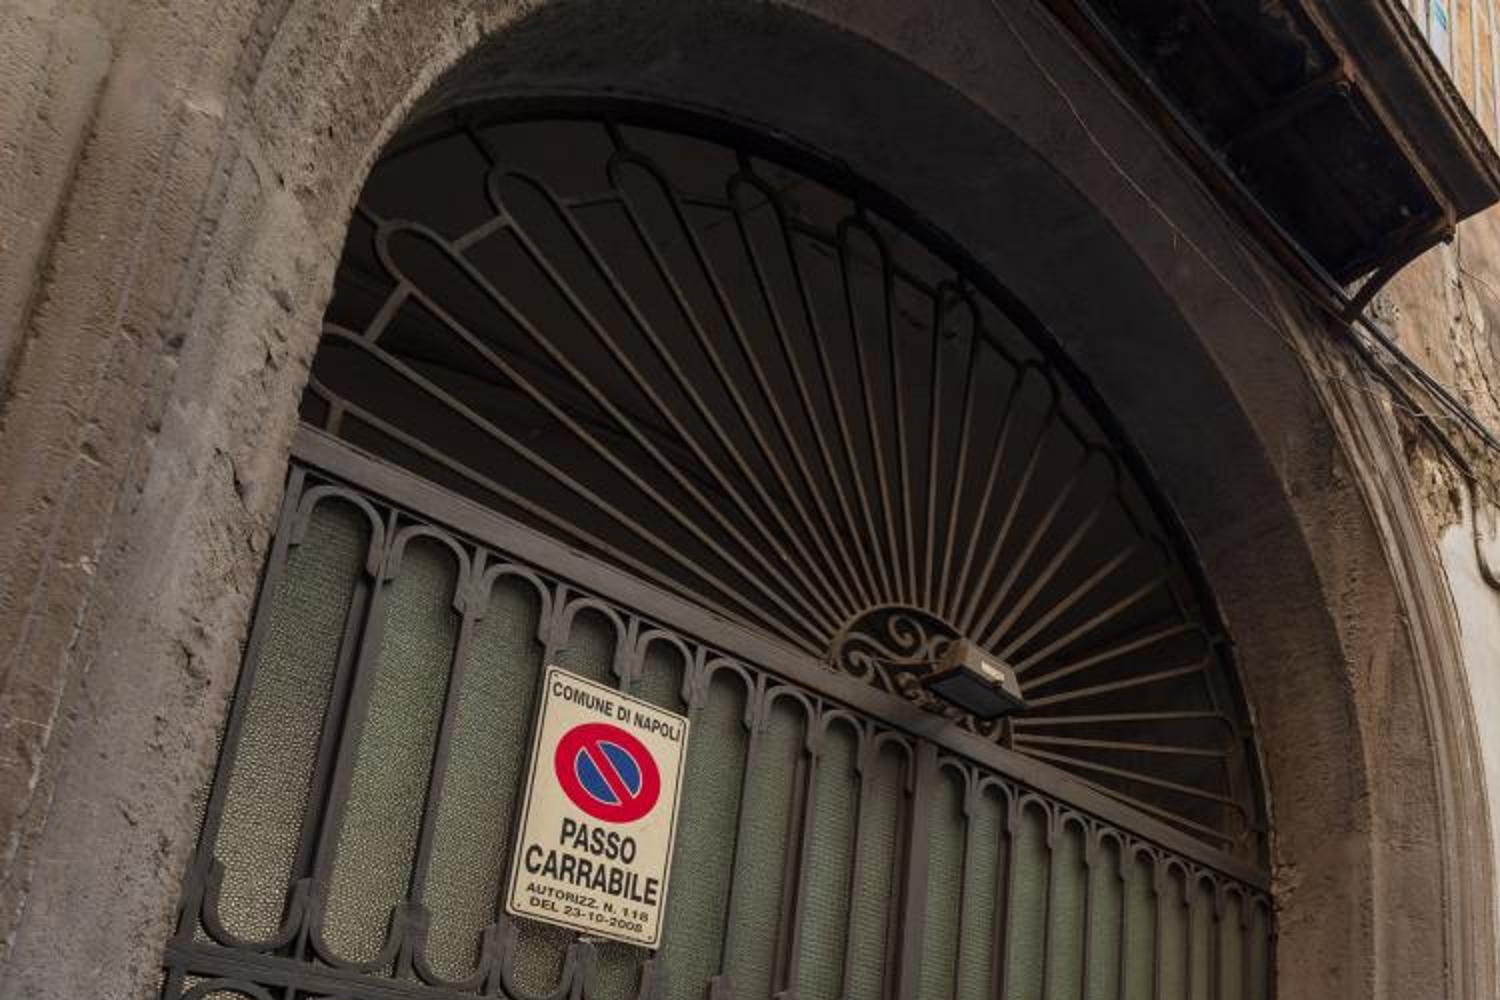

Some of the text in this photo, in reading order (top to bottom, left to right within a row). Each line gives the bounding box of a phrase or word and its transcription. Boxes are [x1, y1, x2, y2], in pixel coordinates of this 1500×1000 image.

[553, 681, 681, 742] COMUNE DI NAPOLI
[560, 817, 637, 865] PASSO
[525, 844, 659, 906] CARRABILE
[527, 882, 601, 910] AUTORIZZ.
[604, 900, 617, 915] N.
[529, 896, 558, 914] DEL
